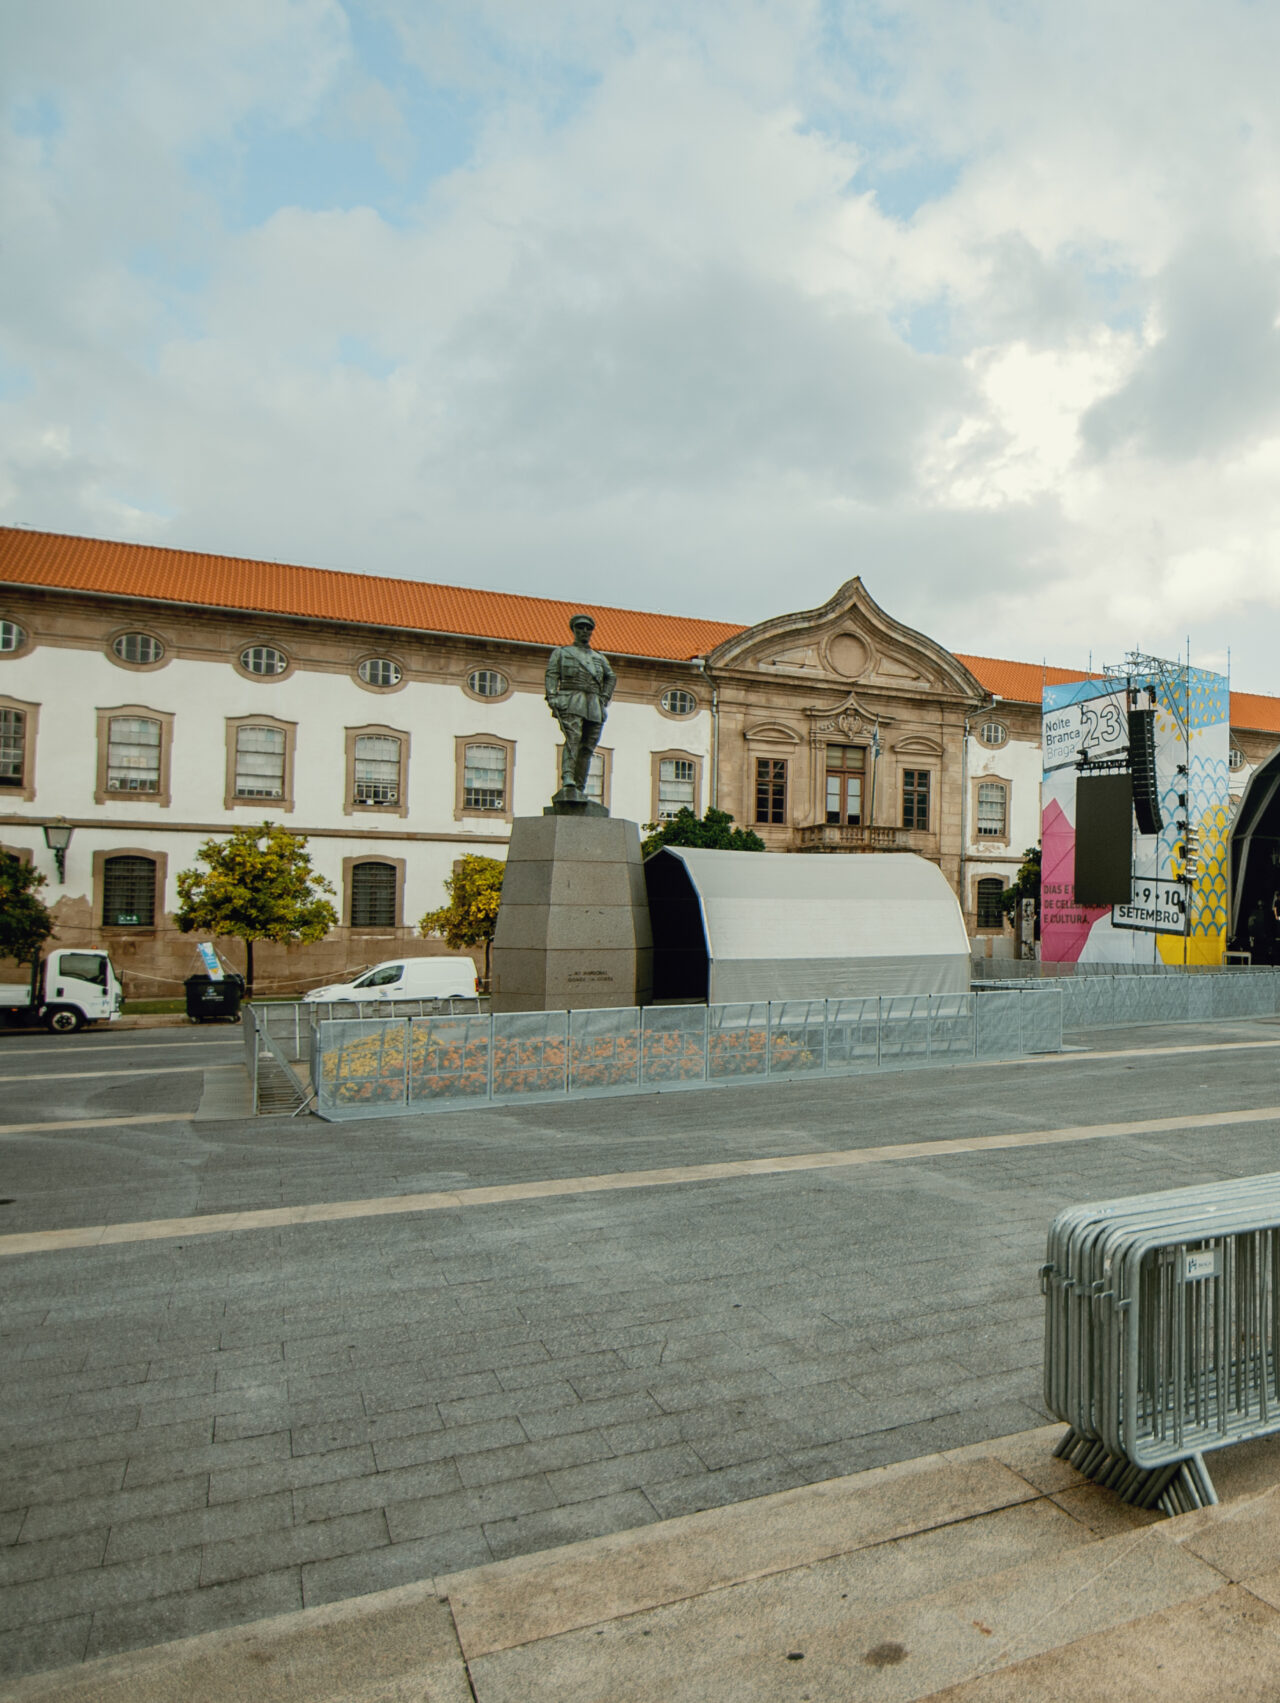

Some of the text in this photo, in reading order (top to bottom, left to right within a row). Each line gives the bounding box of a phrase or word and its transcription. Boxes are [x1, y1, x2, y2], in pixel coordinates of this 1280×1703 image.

[1045, 718, 1071, 733] Noite
[1080, 703, 1122, 750] 23
[1046, 729, 1080, 746] Branca
[1047, 744, 1075, 760] Braga
[1043, 884, 1062, 895] DIAS
[1064, 884, 1069, 894] E
[1143, 888, 1180, 906] 9 10
[1044, 899, 1054, 909] DE
[1043, 914, 1049, 923] E
[1119, 906, 1180, 924] SETEMBRO
